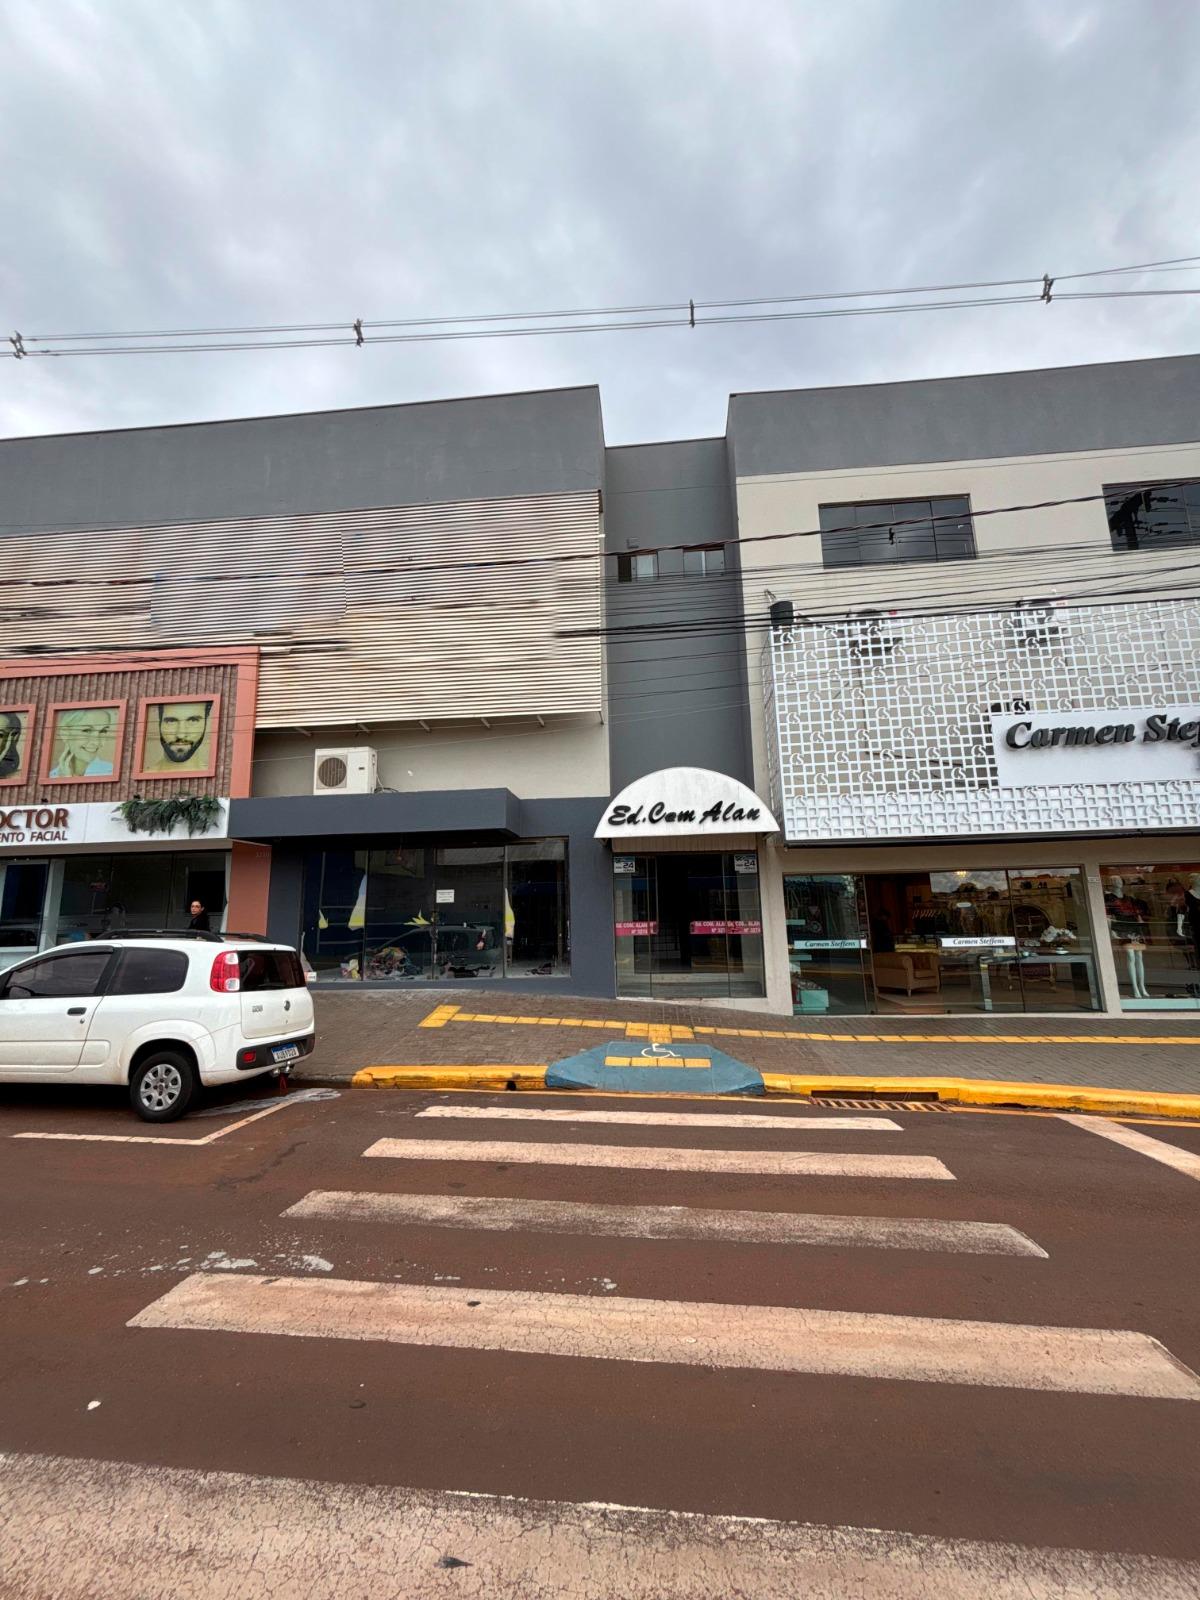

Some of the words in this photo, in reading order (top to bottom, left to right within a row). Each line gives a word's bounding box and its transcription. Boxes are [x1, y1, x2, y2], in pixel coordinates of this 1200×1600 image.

[1005, 722, 1136, 749] Carmen
[699, 800, 760, 825] Alan
[30, 831, 68, 842] FACIAL
[804, 940, 829, 948] Carmen
